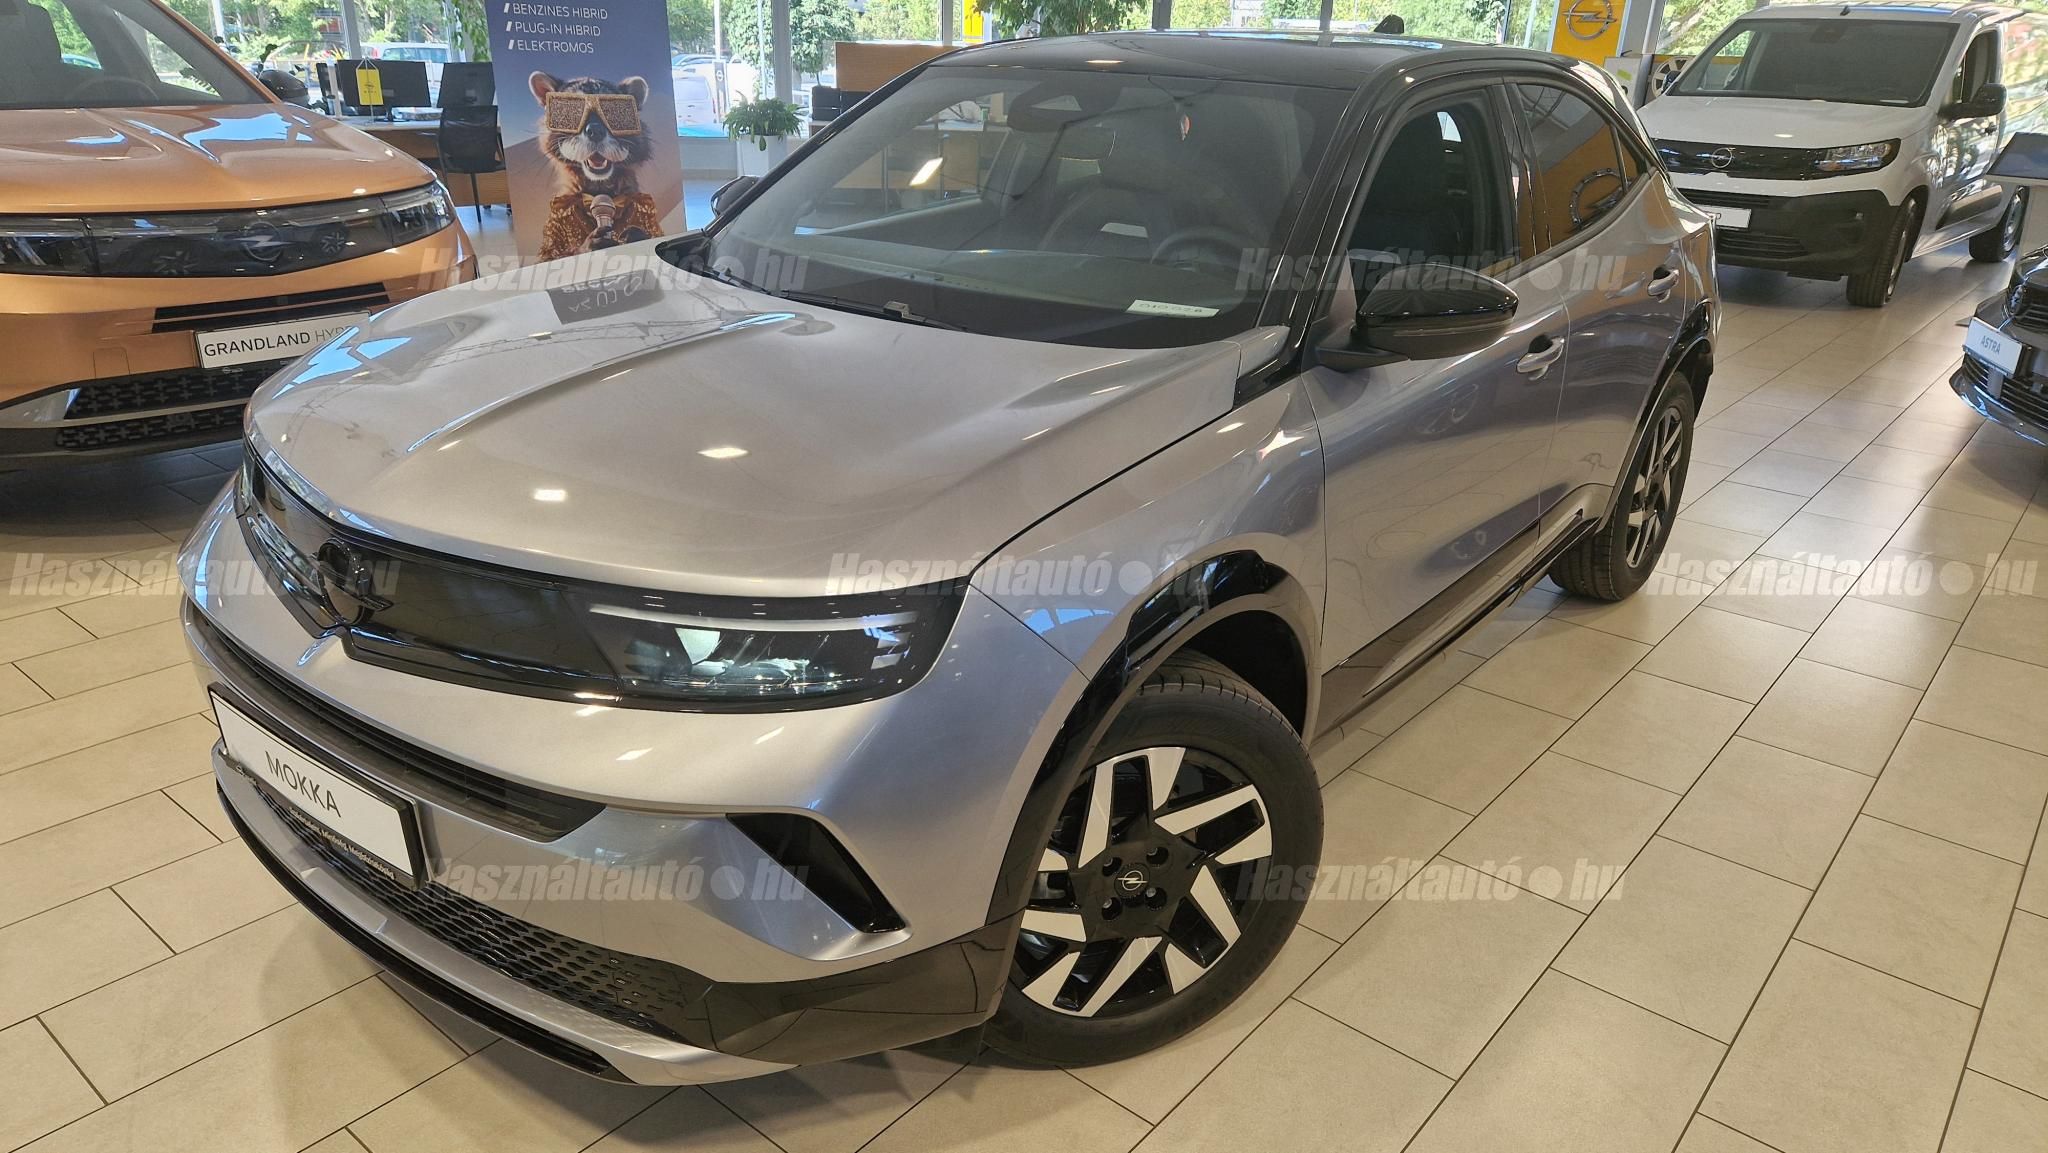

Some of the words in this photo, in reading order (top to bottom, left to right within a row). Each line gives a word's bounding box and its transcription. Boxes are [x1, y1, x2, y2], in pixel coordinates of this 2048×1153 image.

[512, 3, 570, 17] BENZINES
[572, 7, 608, 20] HIBRID
[515, 21, 562, 34] PLUG-IN
[565, 24, 601, 37] HIBRID
[517, 39, 594, 54] ELEKTROMOS
[204, 331, 311, 357] GRANDLAND
[1980, 335, 2001, 355] ASTRA
[264, 750, 342, 818] MOKKA
